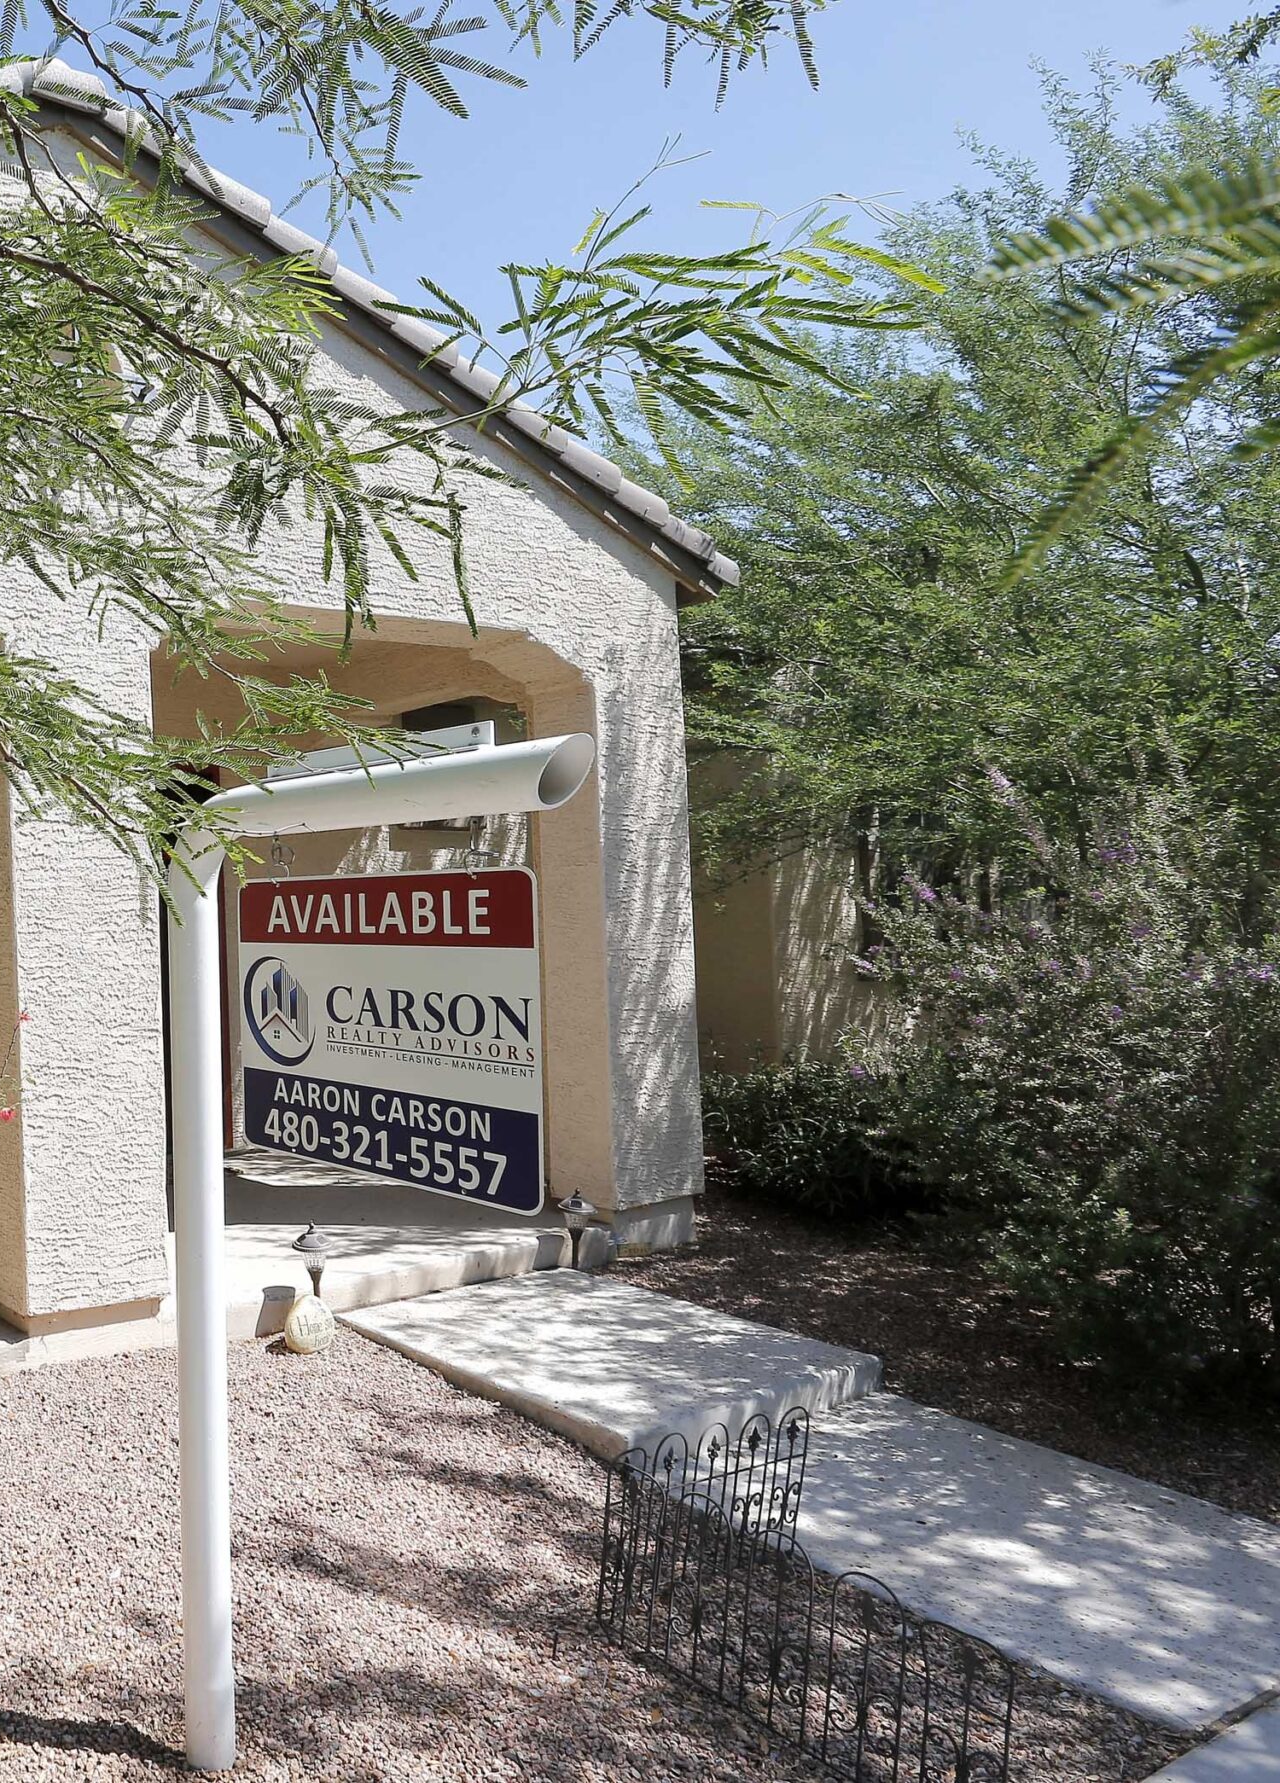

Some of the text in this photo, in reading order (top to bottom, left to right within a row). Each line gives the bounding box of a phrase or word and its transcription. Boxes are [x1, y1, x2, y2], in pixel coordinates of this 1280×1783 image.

[267, 889, 491, 935] AVAILABLE
[326, 985, 534, 1043] CARSON
[326, 1026, 535, 1062] REALTY ADVISORS
[326, 1044, 387, 1059] INVESTMENT
[396, 1053, 442, 1066] LEASING
[451, 1060, 535, 1078] MANAGEMENT
[273, 1078, 491, 1142] AARON CARSON
[264, 1108, 507, 1195] 480-321-5557
